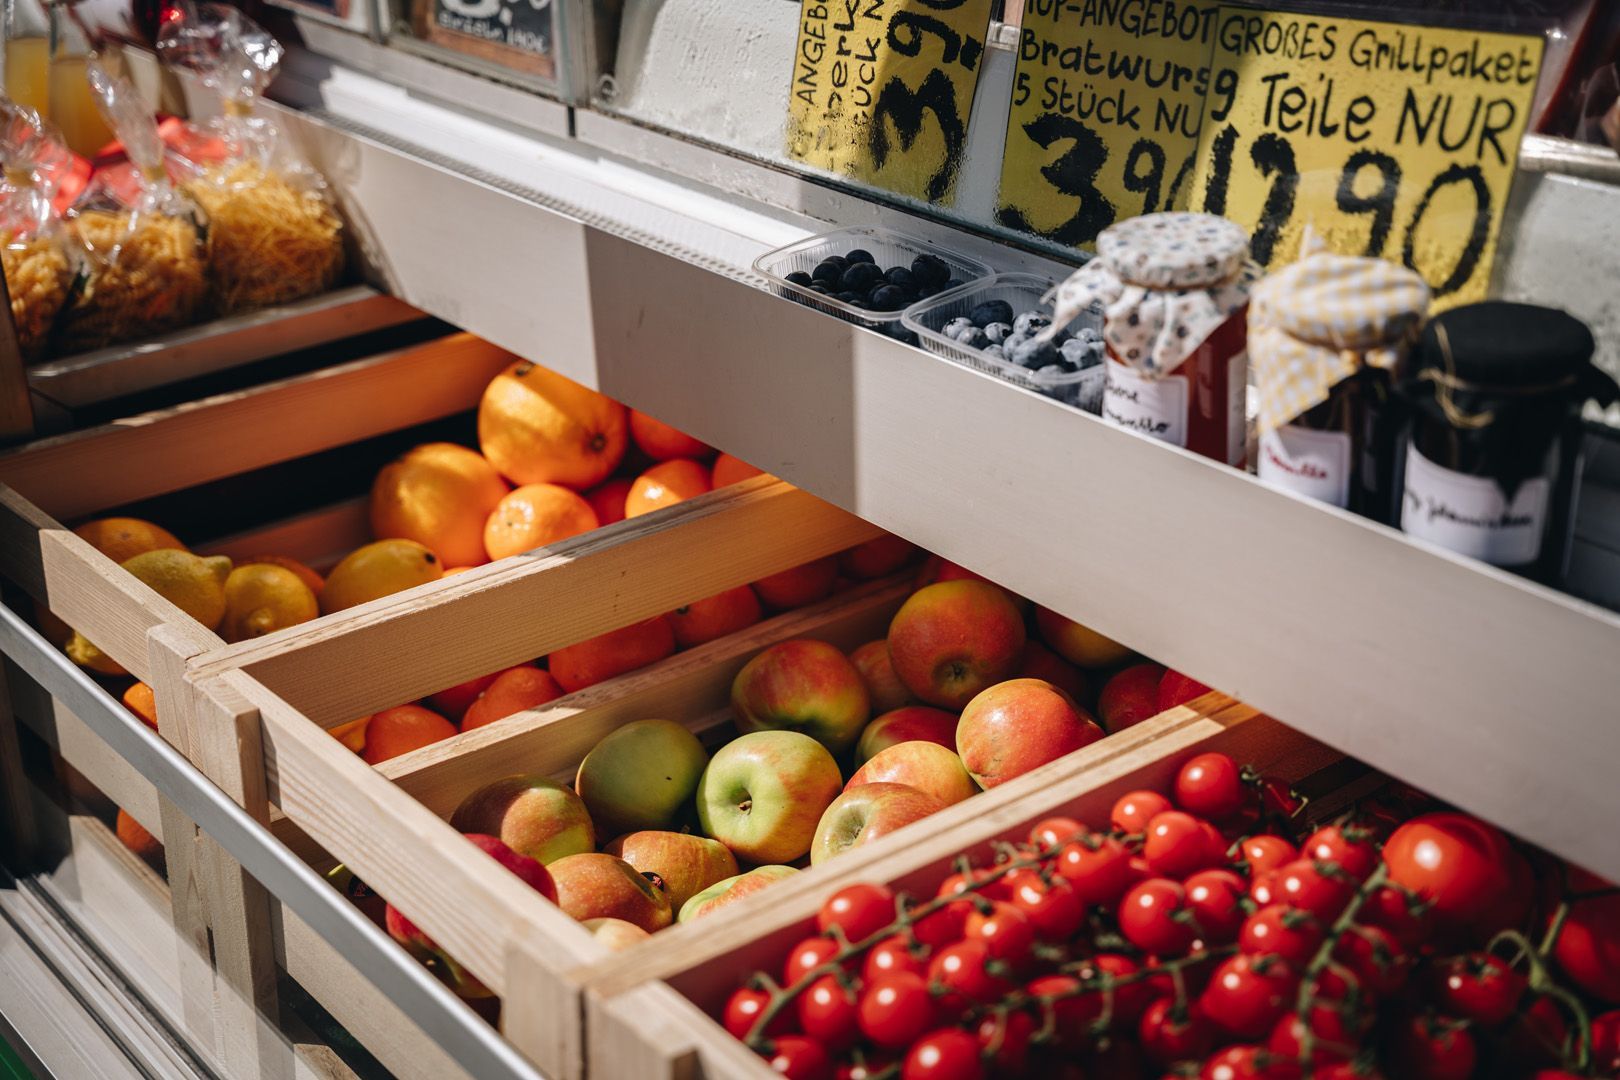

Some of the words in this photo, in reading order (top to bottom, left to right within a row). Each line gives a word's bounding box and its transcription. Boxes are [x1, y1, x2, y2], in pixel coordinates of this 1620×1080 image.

[796, 0, 829, 106] ANGEB
[1349, 29, 1537, 86] Grillpaket
[1014, 72, 1031, 106] 5
[1041, 76, 1141, 131] Stück
[1210, 68, 1239, 122] 9
[1261, 72, 1375, 143] Teile
[1395, 87, 1516, 166] NUR
